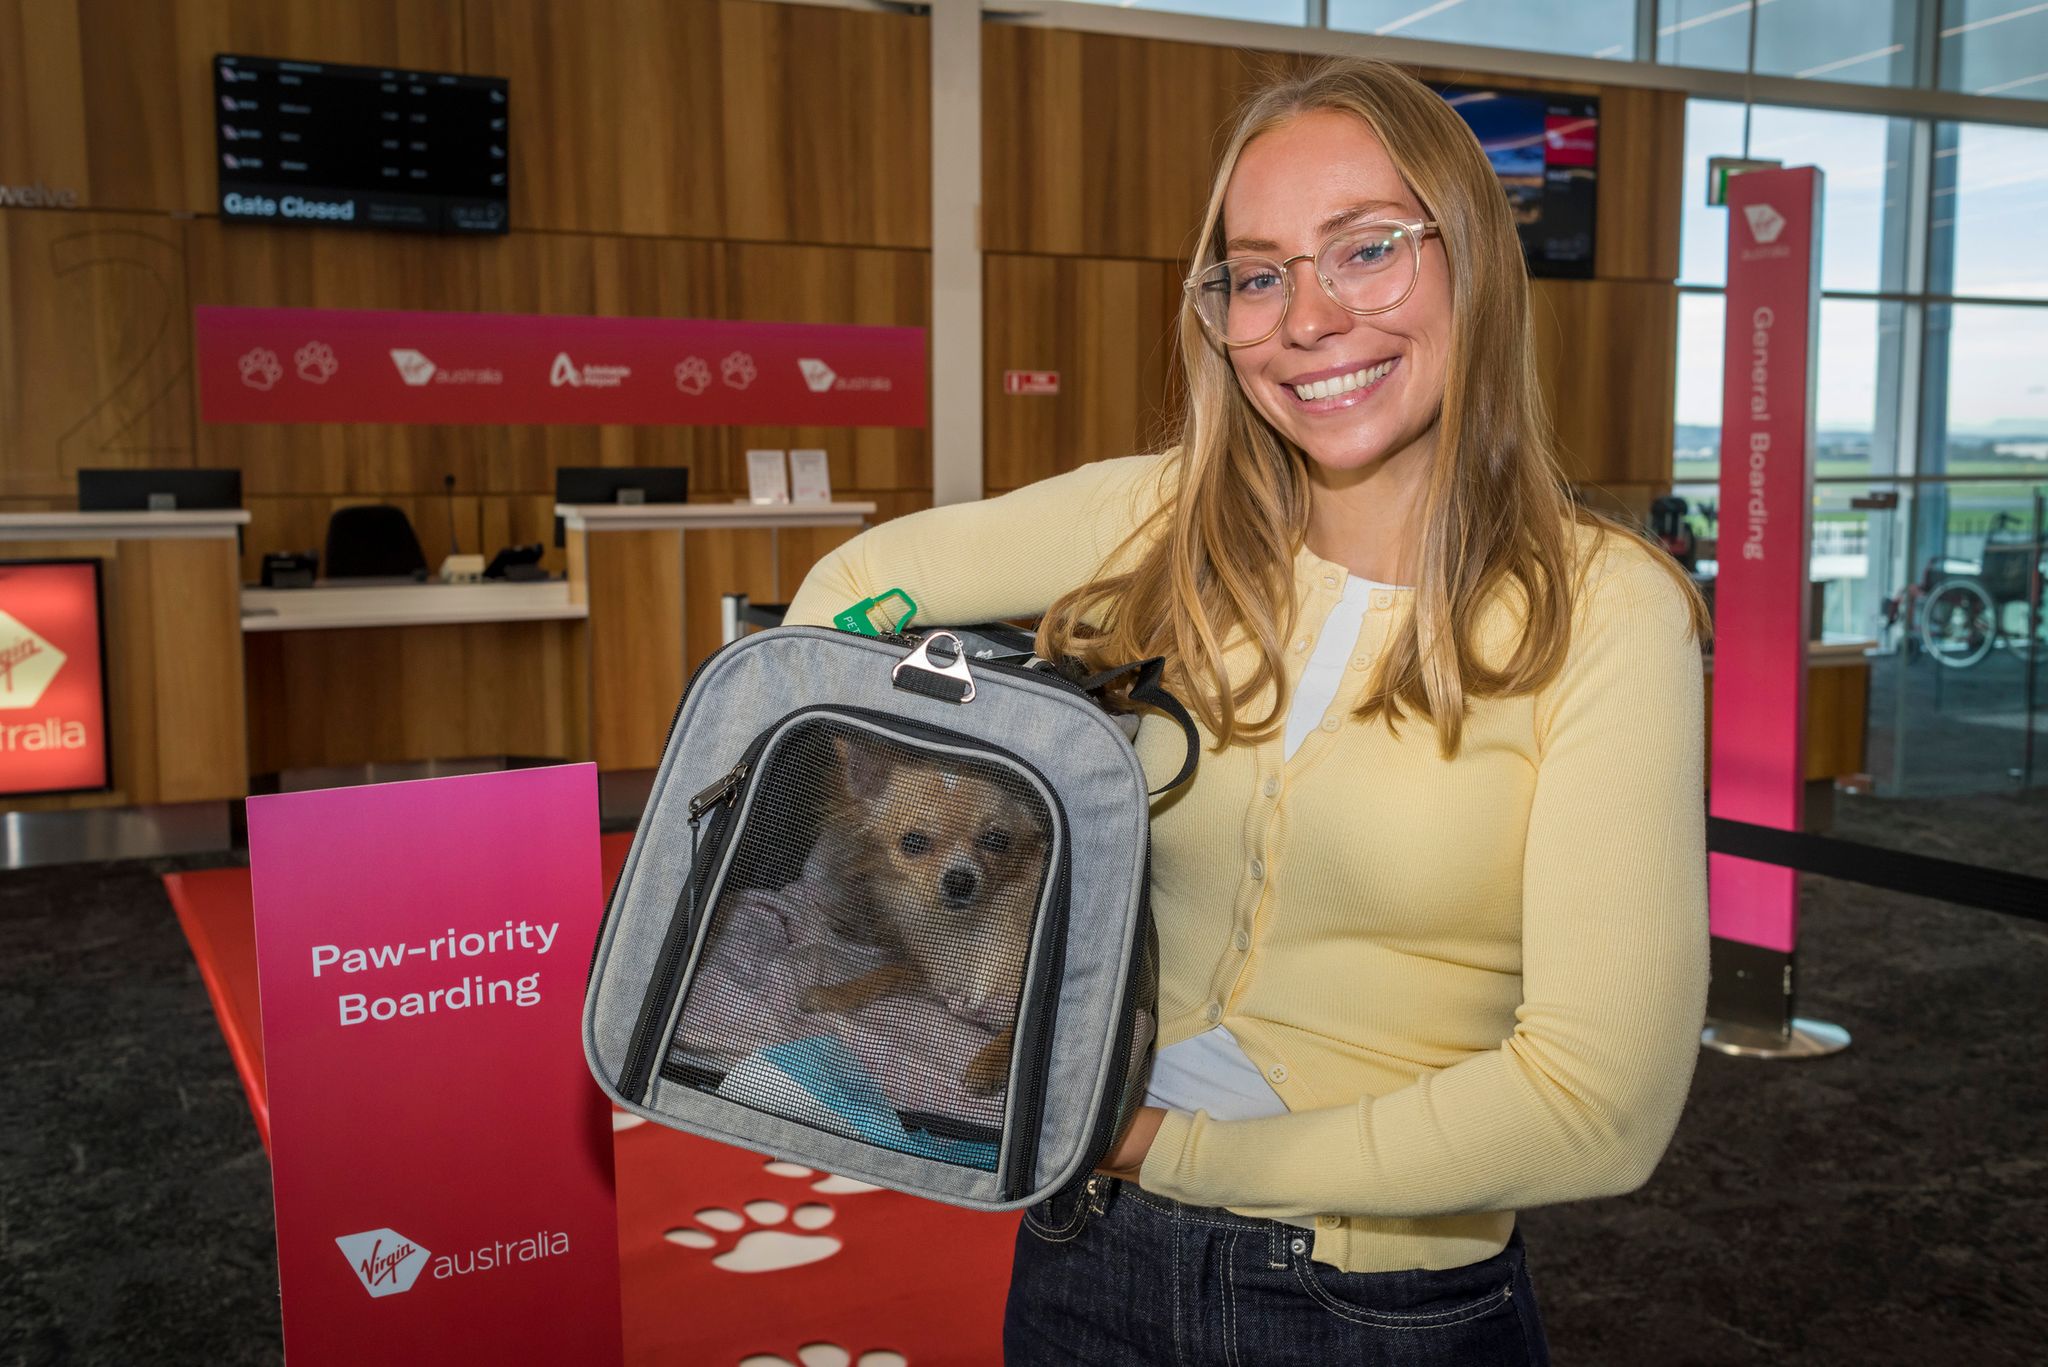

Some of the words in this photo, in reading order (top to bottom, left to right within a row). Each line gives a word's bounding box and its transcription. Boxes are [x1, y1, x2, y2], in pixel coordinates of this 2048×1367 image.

[223, 191, 277, 216] Gate
[279, 195, 355, 221] Closed
[1750, 306, 1775, 421] General
[1743, 432, 1771, 561] Boarding
[844, 616, 861, 633] PET
[311, 920, 560, 978] Paw-riority
[338, 972, 542, 1027] Boarding
[360, 1238, 417, 1287] Virgin
[433, 1230, 570, 1280] australia
